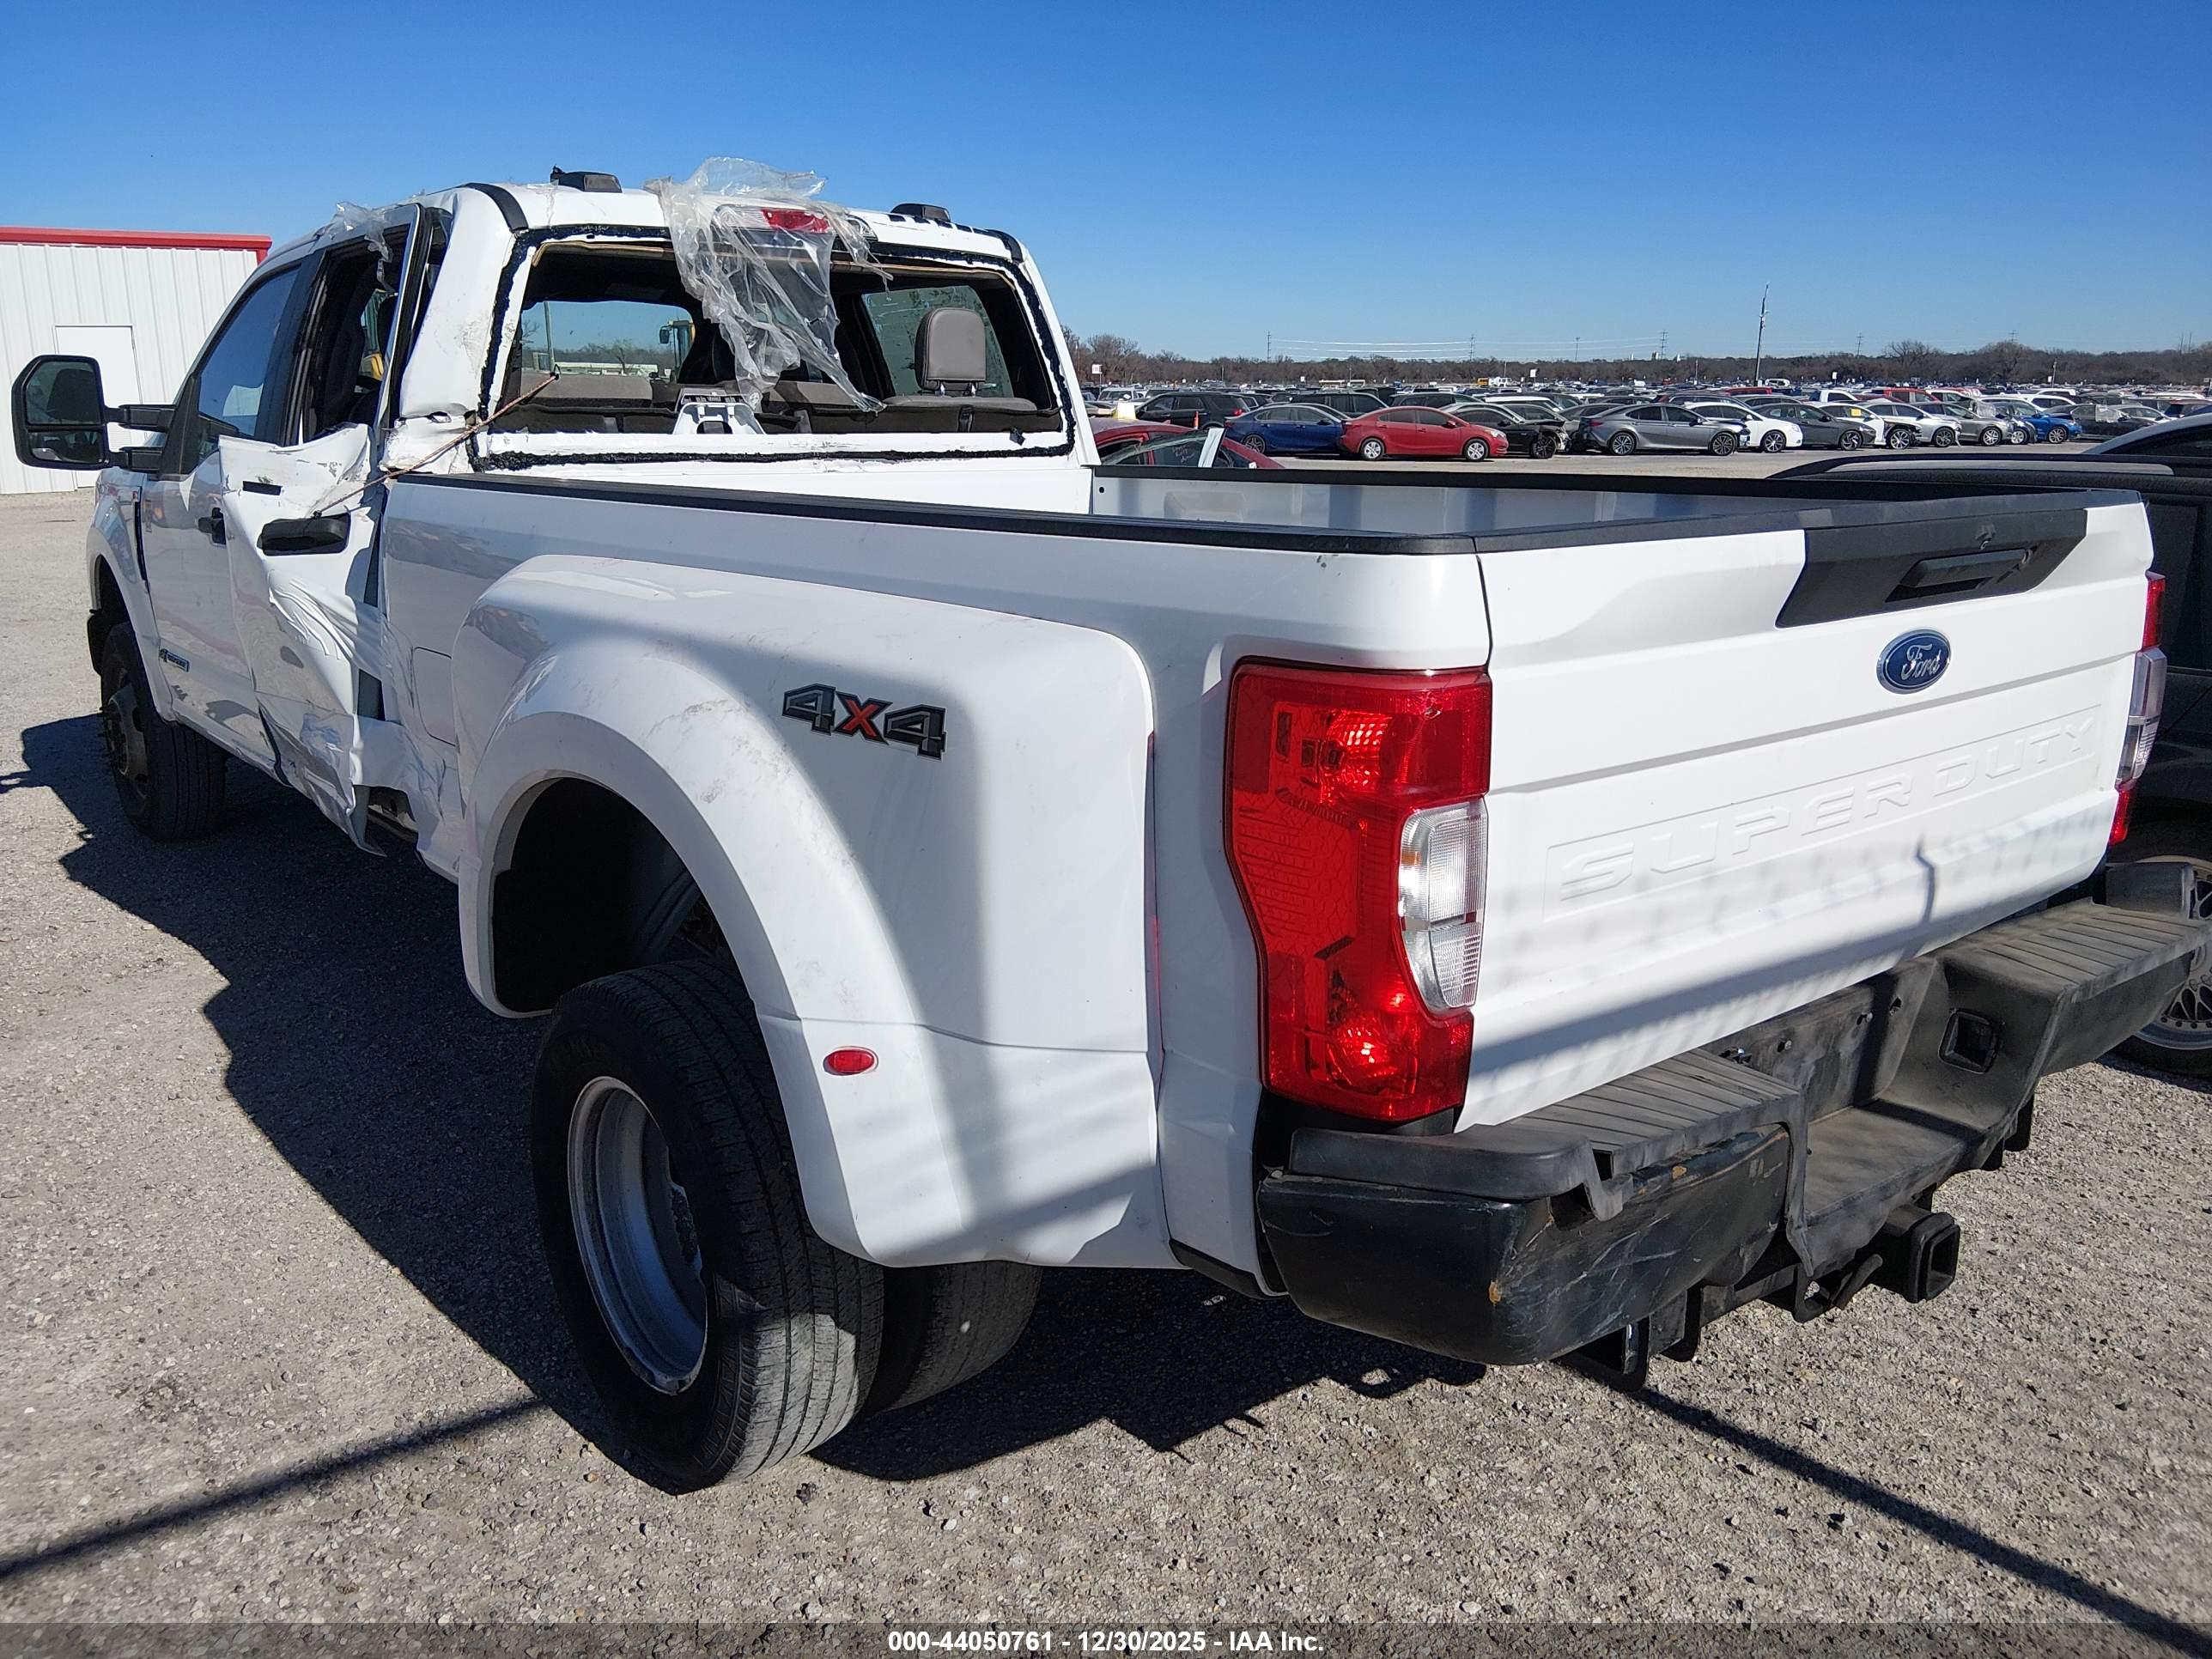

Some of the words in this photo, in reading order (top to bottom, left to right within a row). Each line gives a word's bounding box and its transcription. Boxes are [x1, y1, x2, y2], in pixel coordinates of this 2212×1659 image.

[1900, 643, 1942, 681] Ford
[1559, 770, 1915, 902] SUPER
[1933, 716, 2095, 798] DUTY
